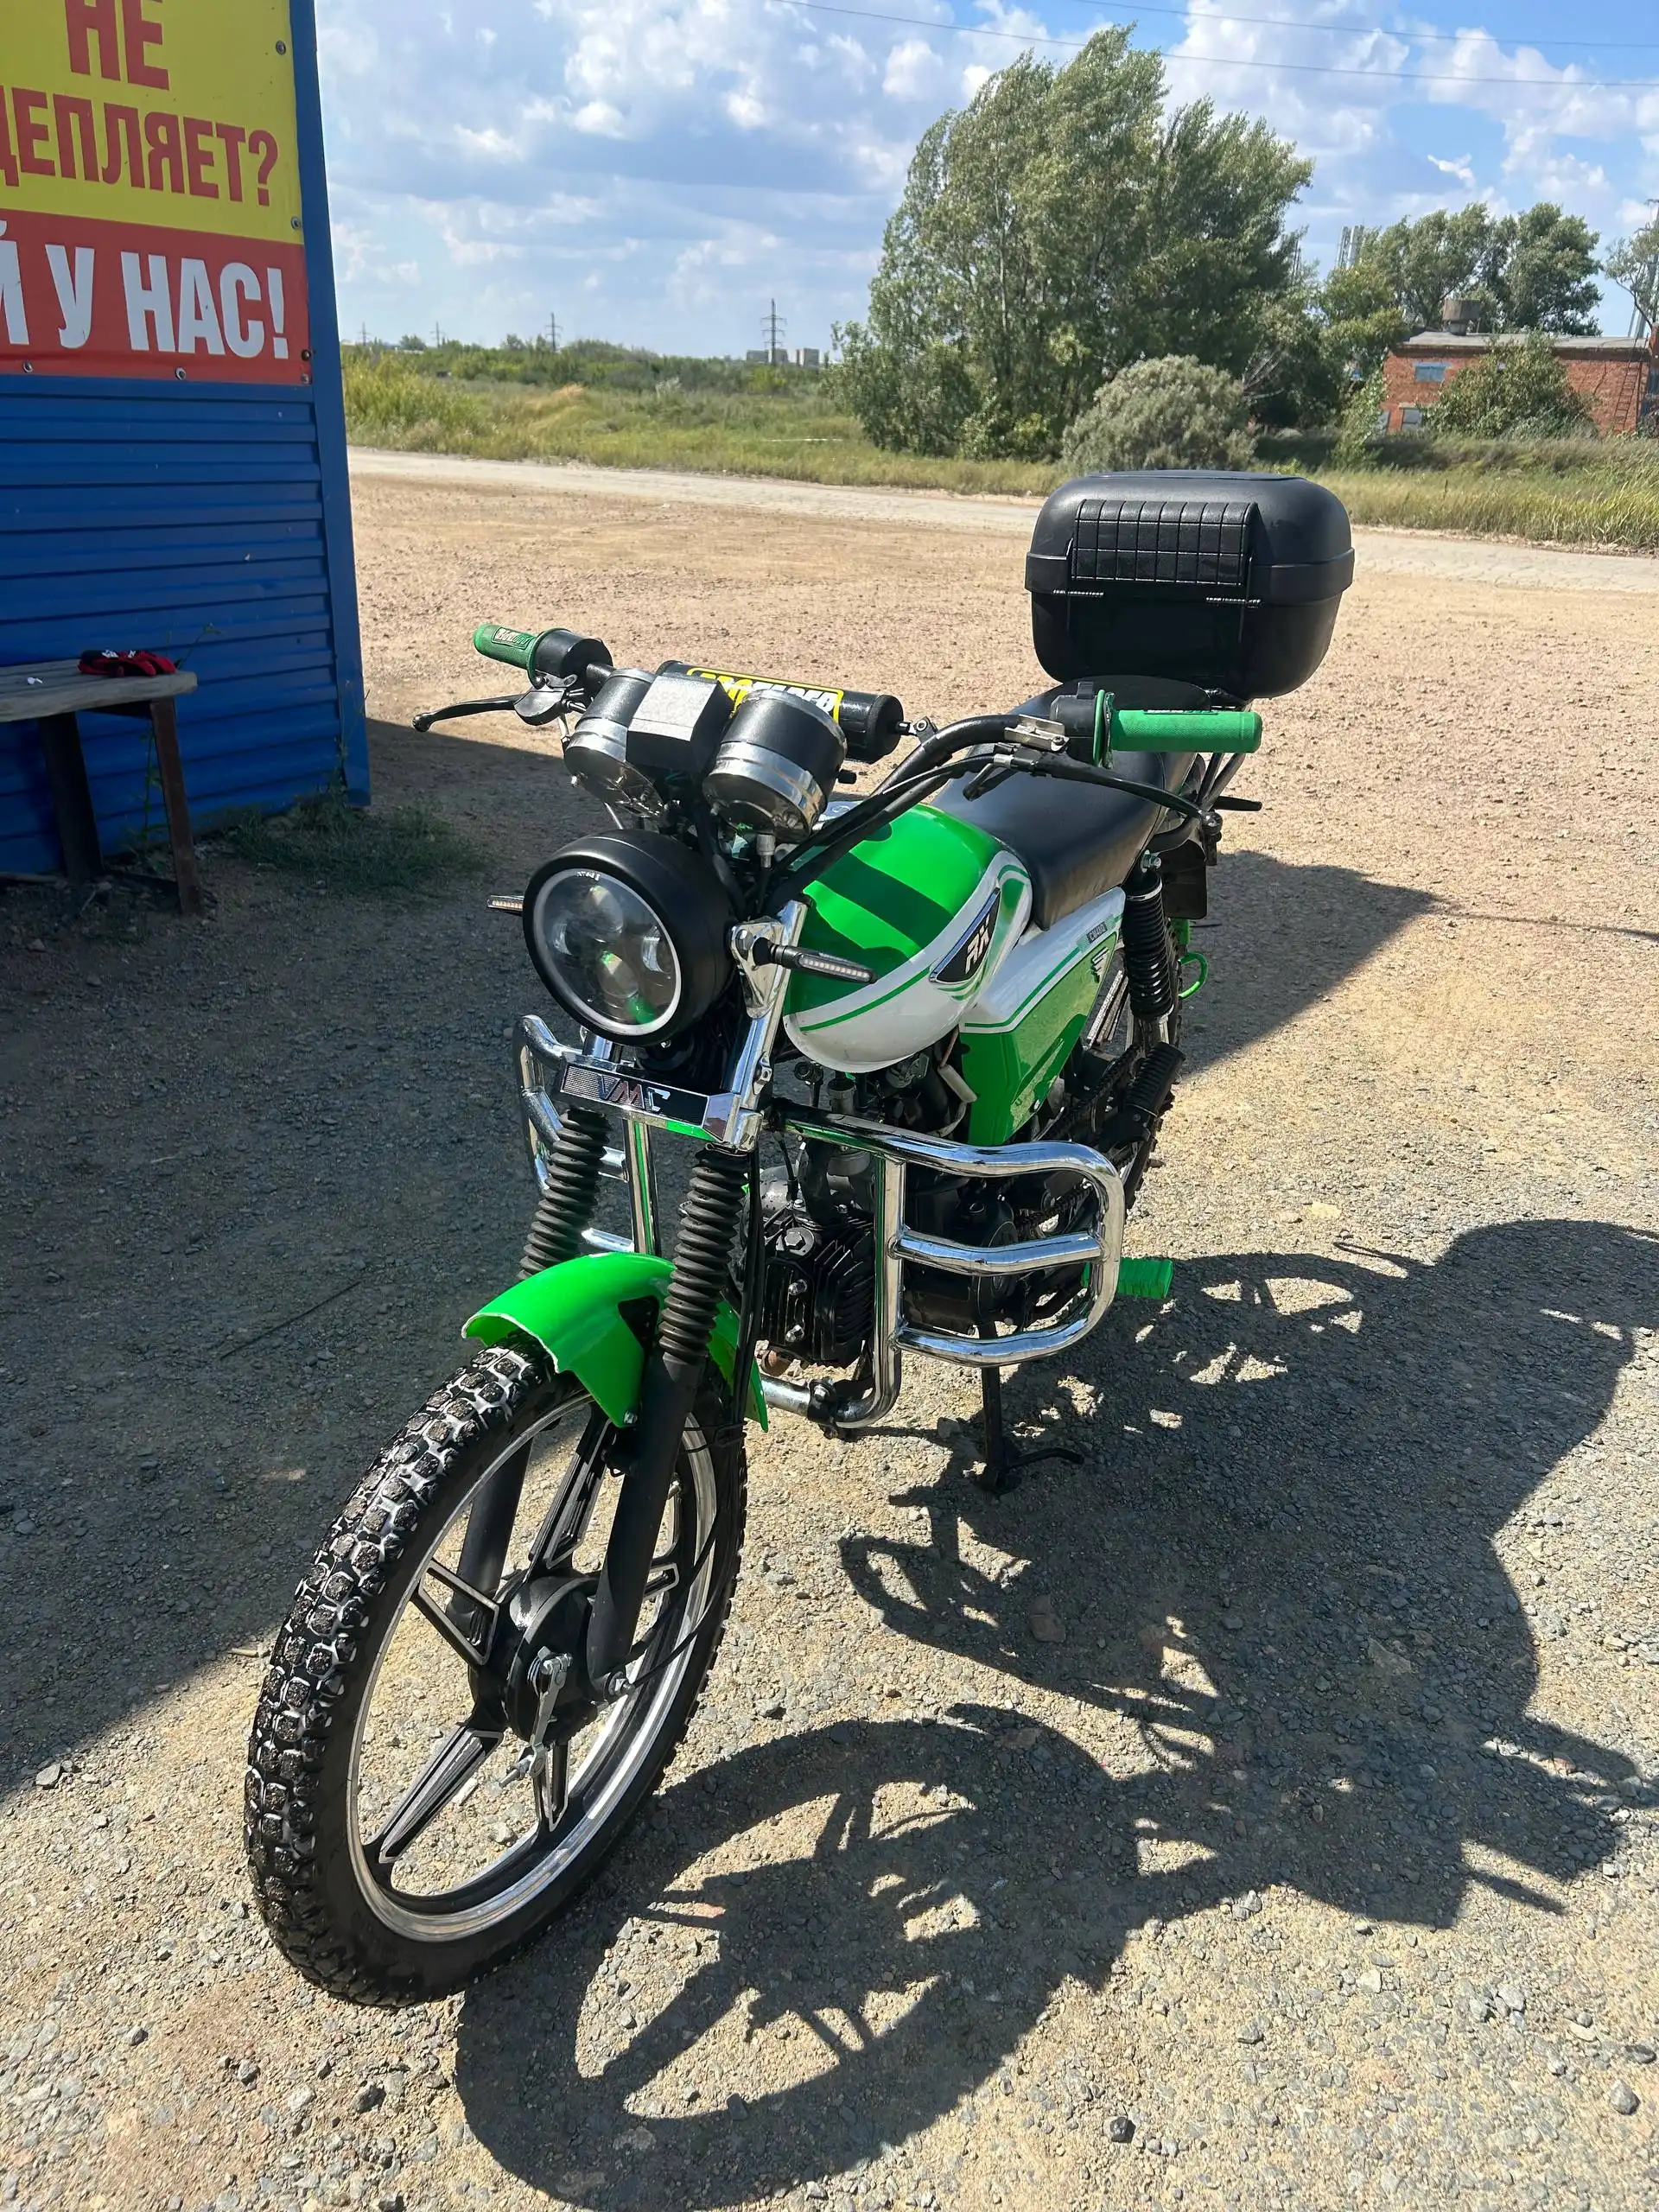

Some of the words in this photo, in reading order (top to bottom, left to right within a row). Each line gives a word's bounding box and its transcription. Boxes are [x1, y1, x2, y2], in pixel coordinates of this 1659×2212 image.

[65, 0, 170, 91] НЕ
[45, 244, 95, 349] У
[121, 251, 289, 359] НАС!
